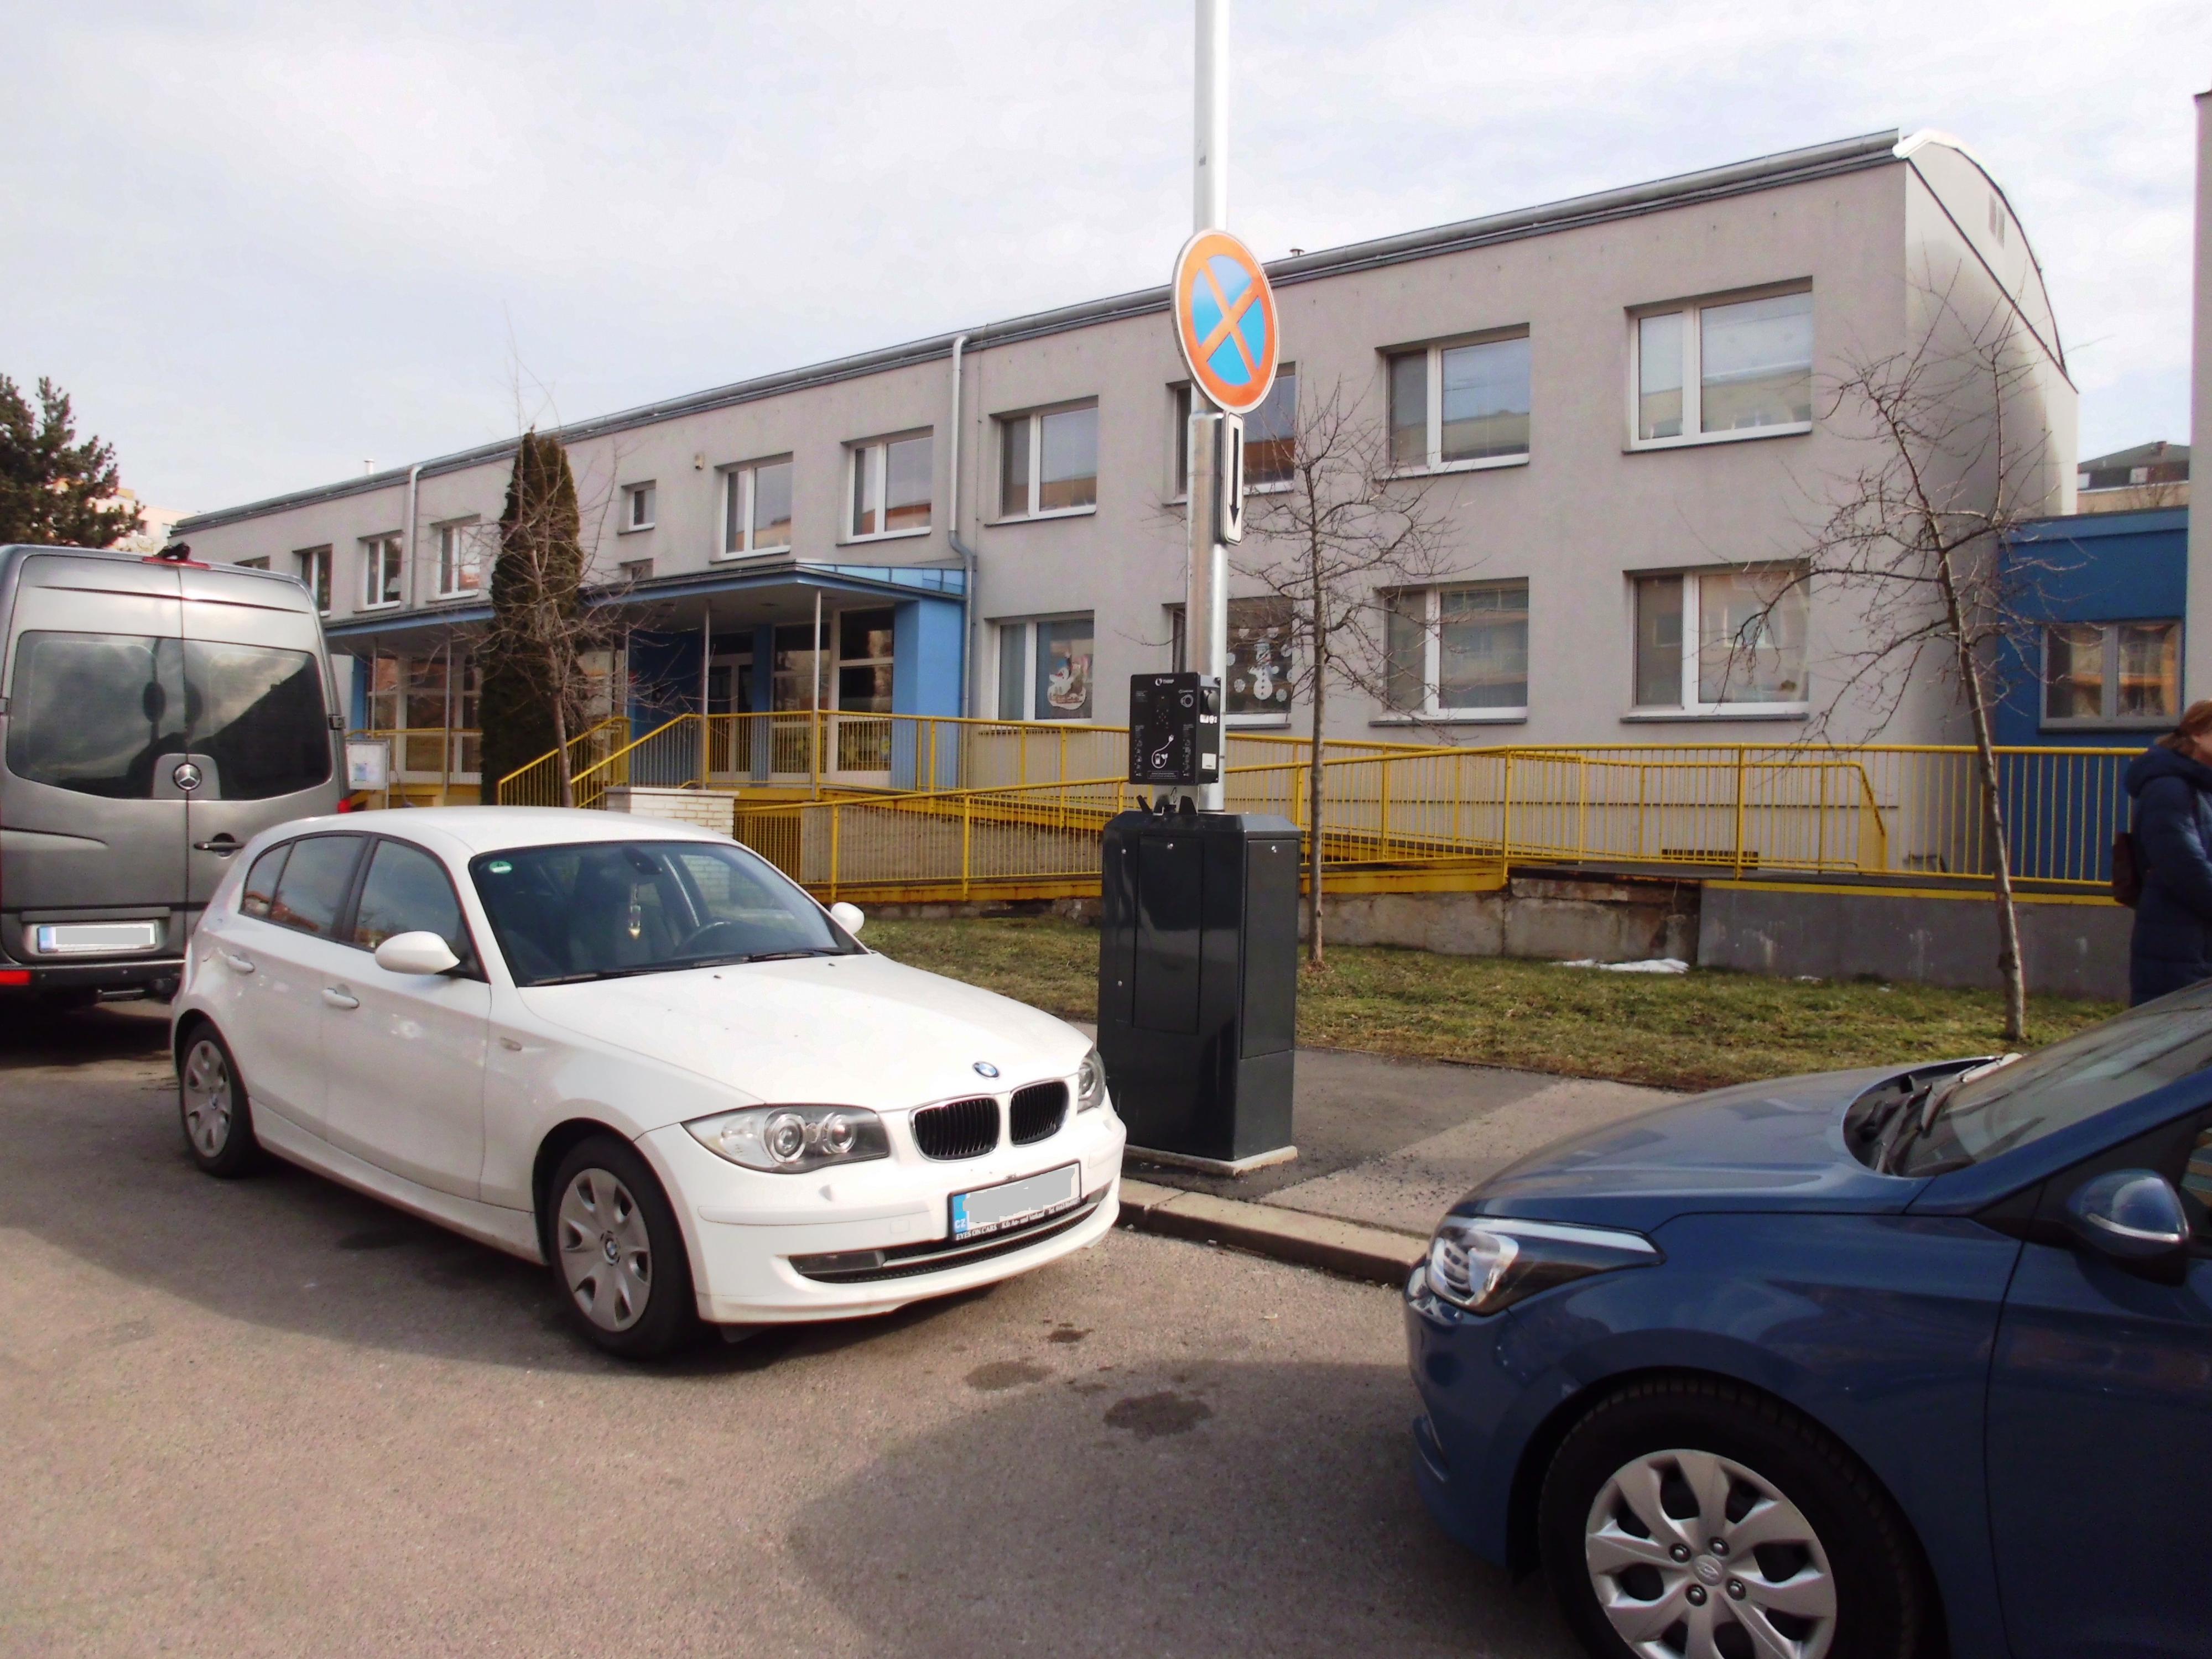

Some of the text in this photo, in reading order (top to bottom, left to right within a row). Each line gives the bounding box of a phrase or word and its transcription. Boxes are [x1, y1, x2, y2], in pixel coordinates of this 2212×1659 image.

[955, 1218, 966, 1228] CZ
[956, 1230, 971, 1240] EYES
[982, 1224, 997, 1234] CARS
